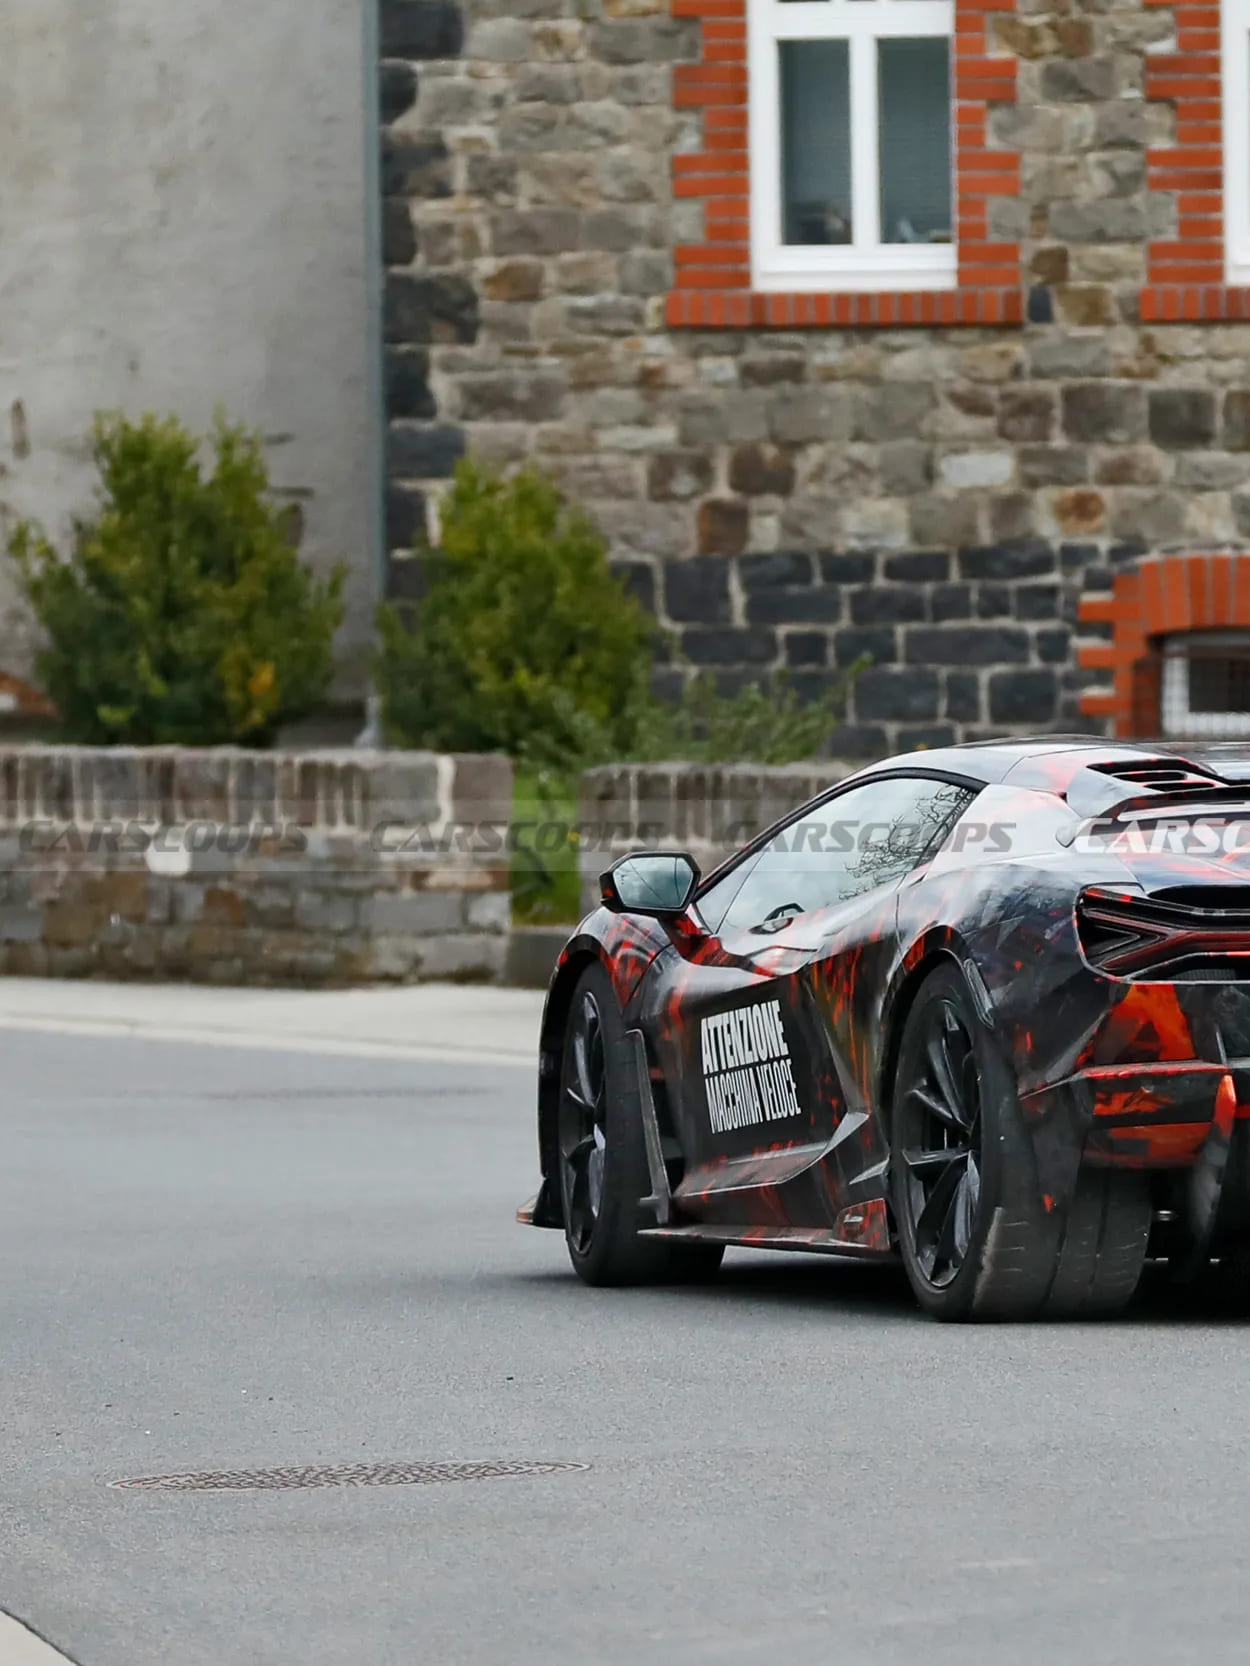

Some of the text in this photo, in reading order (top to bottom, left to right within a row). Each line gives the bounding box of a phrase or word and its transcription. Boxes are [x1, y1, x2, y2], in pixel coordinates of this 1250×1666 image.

[700, 999, 790, 1075] ATTENZIONE
[705, 1058, 802, 1135] MACCHINA VELOCE
